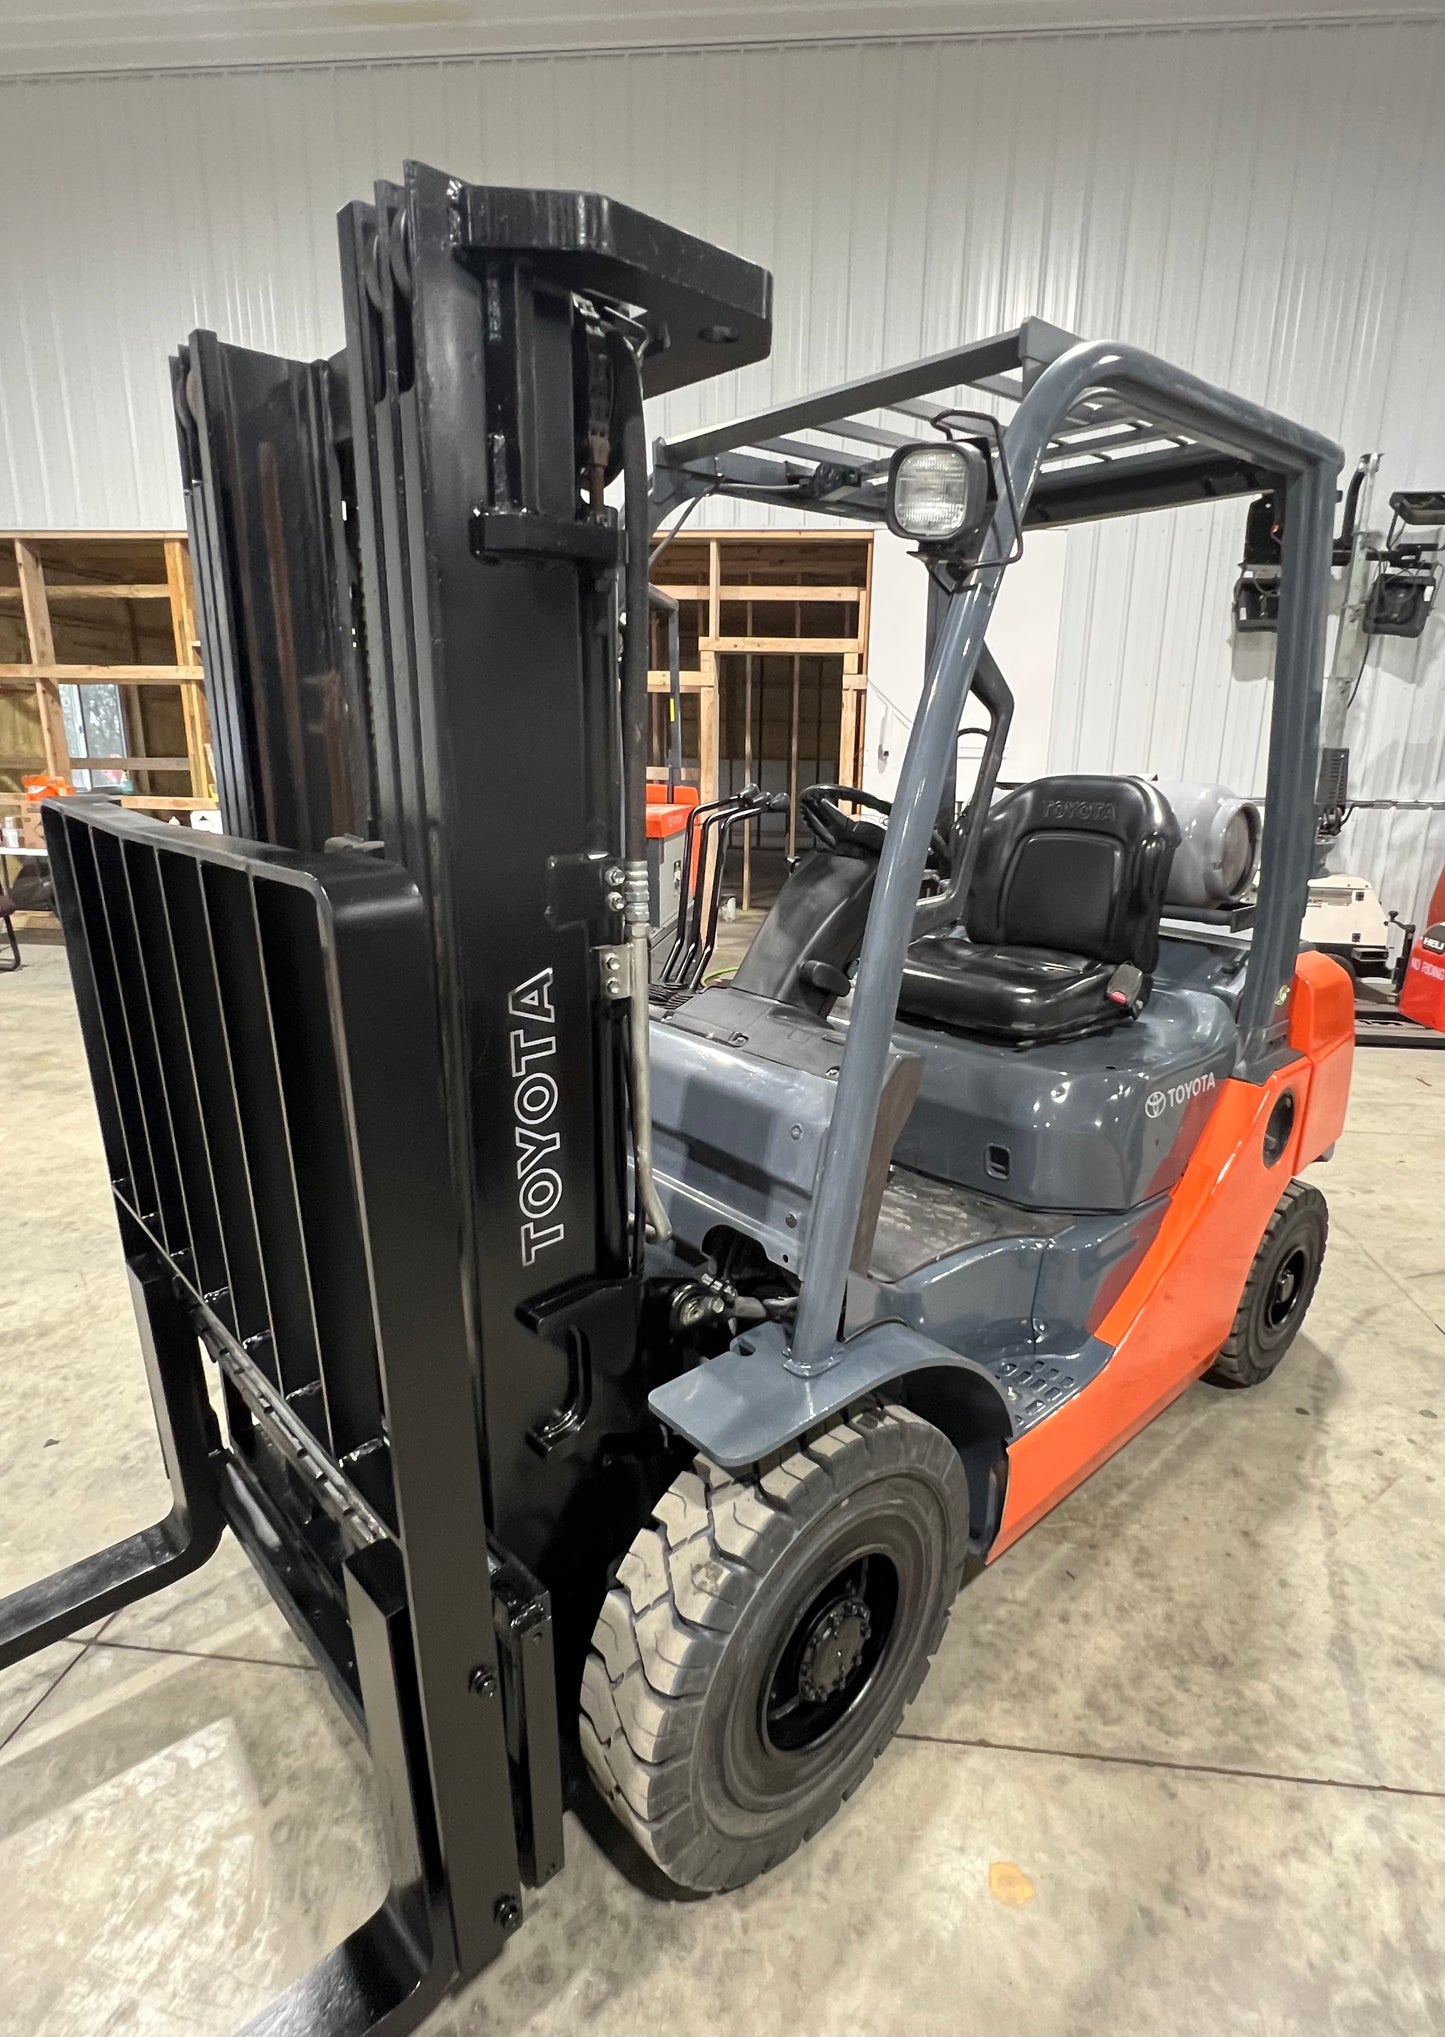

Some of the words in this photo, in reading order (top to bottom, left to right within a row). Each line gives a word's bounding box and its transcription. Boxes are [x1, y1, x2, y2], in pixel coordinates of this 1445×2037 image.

[1041, 800, 1116, 820] TOYOTA
[1167, 1071, 1216, 1108] TOYOTA
[508, 967, 564, 1267] TOYOTA
